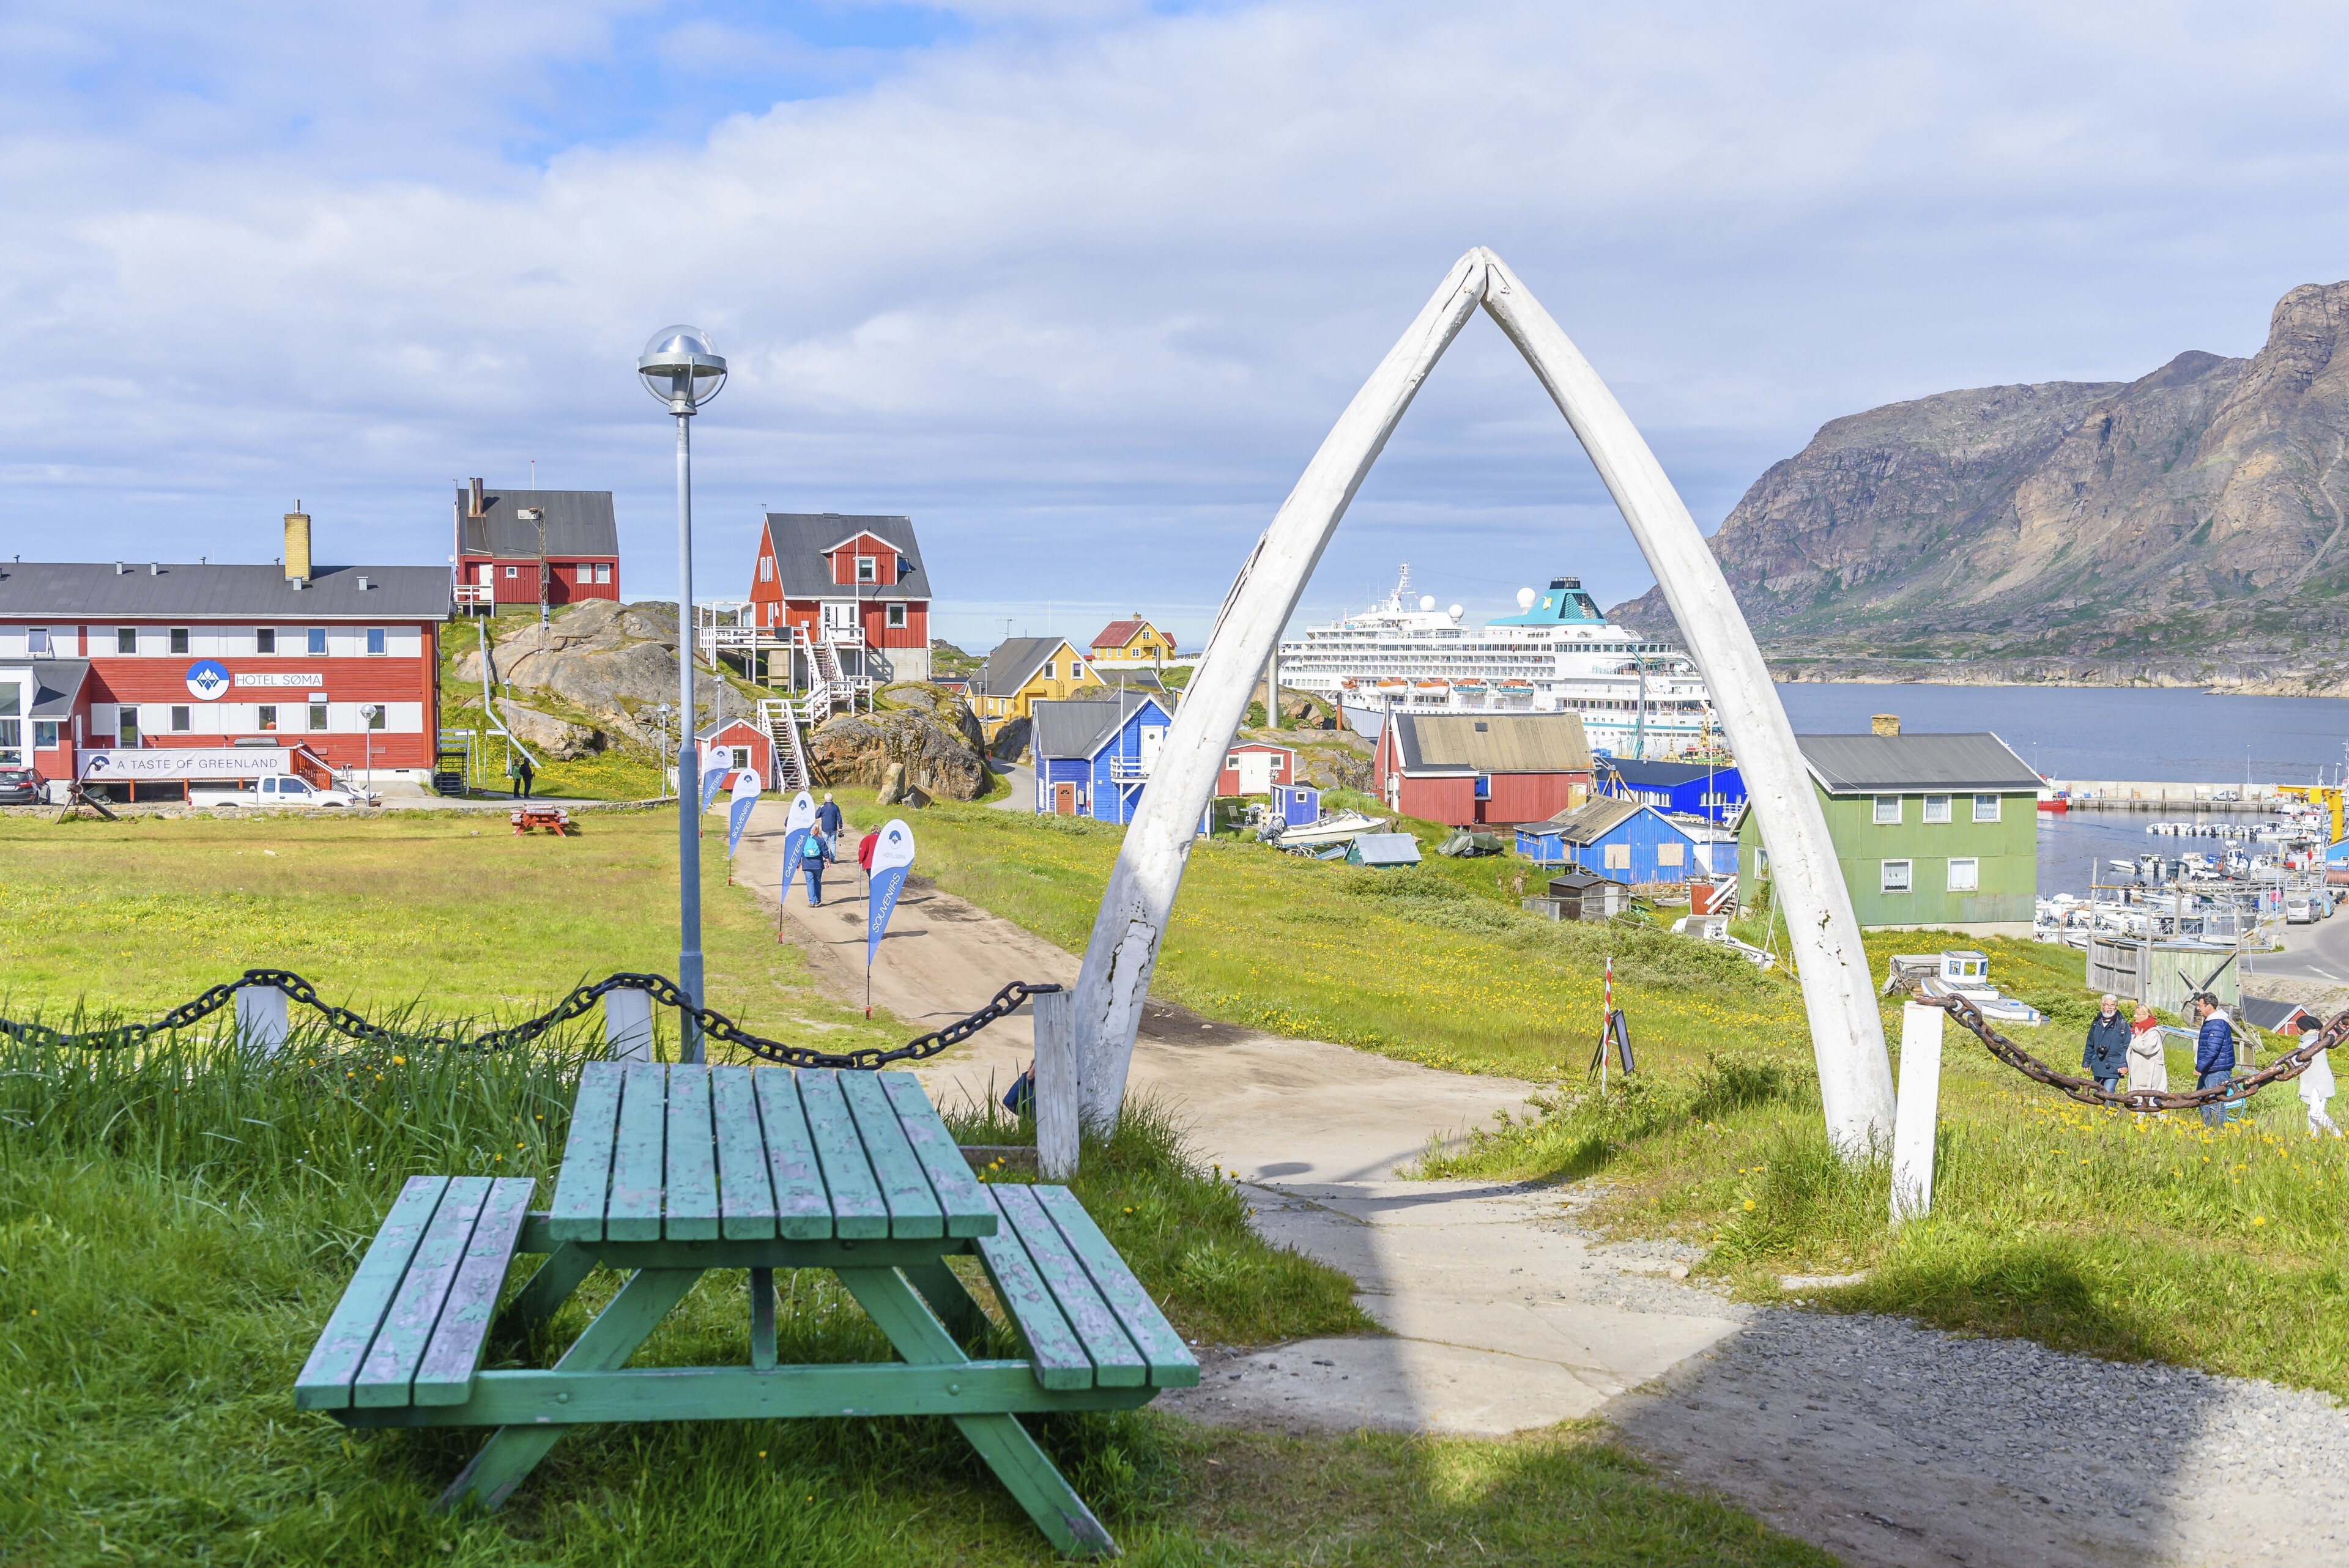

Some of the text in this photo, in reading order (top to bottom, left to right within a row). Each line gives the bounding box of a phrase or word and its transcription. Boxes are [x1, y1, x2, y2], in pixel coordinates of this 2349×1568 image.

[236, 675, 321, 685] HOTEL SØMA
[117, 758, 278, 769] A TASTE OF GREENLAND
[705, 772, 724, 799] CAFETERIA
[732, 800, 751, 838] SOUVENIRS
[785, 834, 806, 878] CAFETERIA
[872, 873, 900, 933] SOUVENIRS
